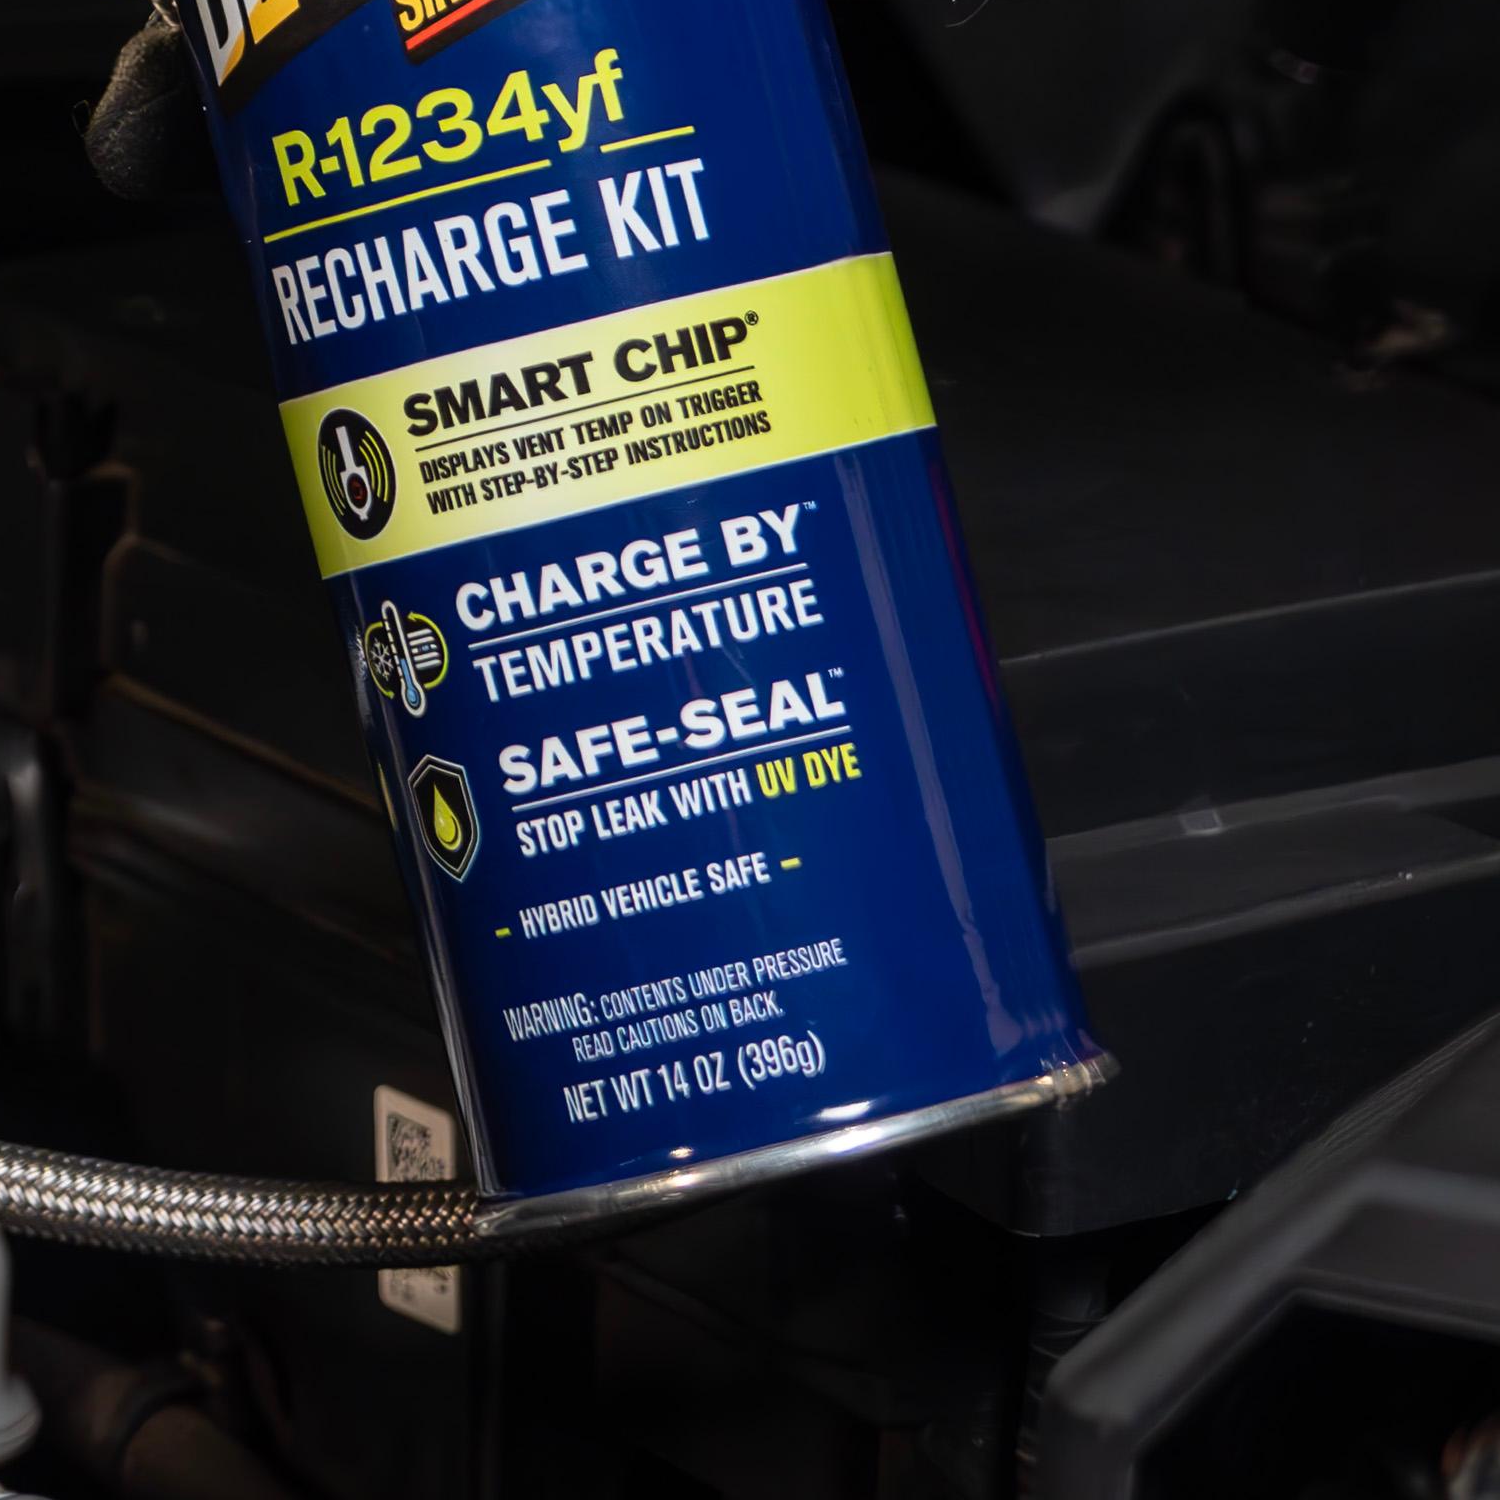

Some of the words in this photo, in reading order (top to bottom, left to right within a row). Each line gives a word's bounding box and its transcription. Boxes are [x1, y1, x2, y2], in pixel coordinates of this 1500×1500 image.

[272, 48, 624, 206] R-1234yf
[270, 189, 589, 345] RECHARGE
[600, 158, 711, 258] KIT
[403, 351, 593, 437] SMART
[418, 444, 510, 484] DISPLAYS
[516, 428, 565, 460] VENT
[572, 412, 633, 445] TEMP
[640, 401, 672, 428] ON
[676, 380, 763, 420] TRIGGER
[426, 480, 478, 515] WITH
[481, 447, 619, 501] STEP-BY-STEP
[626, 410, 772, 465] INSTRUCTIONS
[455, 528, 709, 632] CHARGE
[472, 578, 824, 702] TEMPERATURE
[516, 810, 585, 858] STOP
[591, 789, 669, 841] LEAK
[668, 768, 753, 820] WITH
[755, 757, 799, 799] UV
[802, 743, 862, 789] DYE
[518, 894, 600, 939] HYBRID
[601, 868, 704, 920] VEHICLE
[706, 852, 771, 894] SAFE
[503, 992, 601, 1043] WARNING:
[600, 977, 687, 1022] CONTENTS
[688, 961, 751, 998] UNDER
[752, 938, 847, 986] PRESSURE
[572, 1031, 616, 1063] READ
[616, 1009, 699, 1051] CAUTIONS
[700, 1003, 730, 1033] ON
[729, 990, 785, 1027] BACK.
[563, 1079, 609, 1124] NET
[610, 1068, 654, 1113] WT
[658, 1061, 690, 1102] 14
[694, 1051, 731, 1095] OZ
[738, 1030, 827, 1091] (396g)
